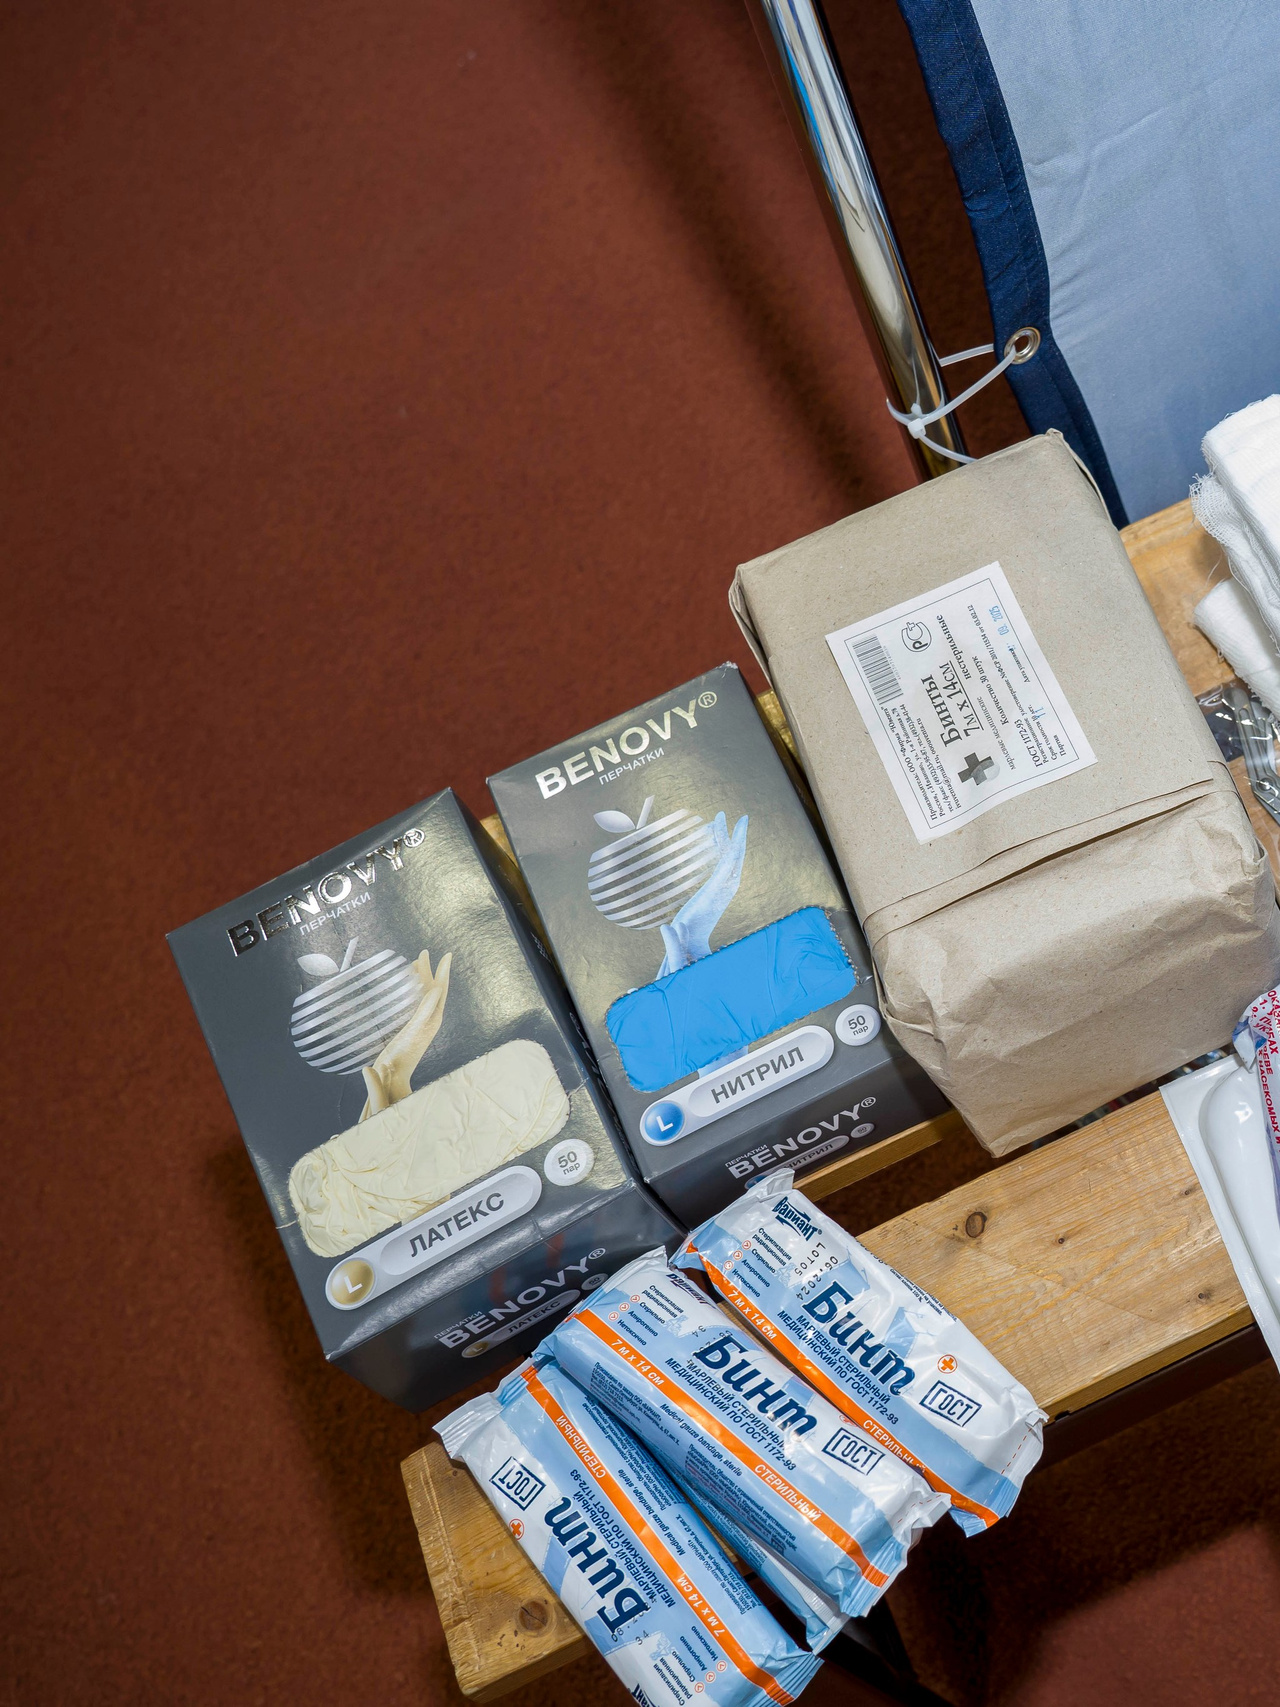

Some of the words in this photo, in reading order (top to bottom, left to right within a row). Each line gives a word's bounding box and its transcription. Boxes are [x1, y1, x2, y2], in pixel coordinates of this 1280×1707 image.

[935, 612, 973, 680] нестерильные
[970, 654, 986, 675] штук
[979, 674, 988, 684] 30
[920, 674, 963, 748] Бинты
[975, 694, 1001, 740] медицинские
[983, 682, 1009, 726] Количество
[1013, 717, 1031, 744] 1172-93
[597, 745, 664, 786] ПЕРЧАТКИ
[903, 755, 916, 773] ООО
[1025, 743, 1042, 767] ГОСТ
[298, 891, 372, 935] ПЕРЧАТКИ
[846, 1013, 867, 1031] 50
[852, 1023, 869, 1037] пар
[654, 1111, 674, 1132] L
[709, 1045, 805, 1105] НИТРИЛ
[558, 1151, 578, 1169] 50
[563, 1162, 581, 1175] пар
[724, 1142, 767, 1168] ПЕРЧАТКИ
[342, 1272, 362, 1293] L
[408, 1191, 508, 1259] ЛАТЕКС
[751, 1233, 787, 1266] радиационная
[756, 1226, 793, 1261] Стерилизация
[739, 1258, 772, 1288] Апирогенно
[749, 1248, 777, 1274] Стерильно
[506, 1299, 562, 1333] ЛАТЕКС
[638, 1300, 665, 1325] Стерильно
[642, 1287, 678, 1320] радиационная
[648, 1283, 684, 1315] Стерилизация
[727, 1289, 738, 1300] 7
[750, 1312, 765, 1326] 14
[760, 1323, 778, 1340] см
[433, 1310, 483, 1339] ПЕРЧАТКИ
[616, 1319, 647, 1347] Нетоксично
[627, 1309, 658, 1338] Апирогенно
[802, 1279, 916, 1398] Бинт
[611, 1337, 622, 1349] 7
[635, 1359, 650, 1373] 14
[647, 1370, 664, 1386] см
[775, 1309, 839, 1368] МЕДИЦИНСКИЙ
[834, 1365, 848, 1379] ПО
[845, 1376, 868, 1398] ГОСТ
[866, 1395, 899, 1425] 1172-93
[794, 1313, 841, 1357] МАРЛЕВЫЙ
[836, 1353, 892, 1404] СТЕРИЛЬНЫЙ
[686, 1359, 734, 1404] МАРЛЕВЫЙ
[693, 1333, 818, 1438] Бинт
[663, 1354, 730, 1415] МЕДИЦИНСКИЙ
[726, 1408, 743, 1425] ПО
[739, 1420, 766, 1445] ГОСТ
[763, 1441, 796, 1472] 1172-93
[927, 1382, 973, 1427] ГОСТ
[554, 1414, 607, 1480] СТЕРИЛЬНЫЙ
[679, 1421, 699, 1439] gauze
[696, 1435, 725, 1462] bandage,
[722, 1457, 743, 1477] sterile
[830, 1429, 877, 1475] ГОСТ
[496, 1461, 540, 1506] ГОСТ
[569, 1468, 597, 1501] 1172-93
[616, 1467, 635, 1488] sterile
[753, 1460, 823, 1523] СТЕРИЛЬНЫЙ
[592, 1499, 614, 1525] ГОСТ
[630, 1484, 656, 1515] bandage,
[571, 1489, 620, 1551] СТЕРИЛЬНЫЙ
[610, 1522, 625, 1539] ПО
[651, 1511, 669, 1532] gauze
[664, 1530, 685, 1556] Medical
[543, 1496, 652, 1635] Бинт
[613, 1547, 657, 1601] МАРЛЕВЫЙ
[618, 1536, 677, 1609] МЕДИЦИНСКИЙ
[676, 1575, 693, 1593] см
[688, 1592, 703, 1608] 14
[689, 1624, 718, 1661] Нетоксично
[713, 1625, 725, 1637] 7
[670, 1649, 696, 1682] Стерильно
[678, 1634, 708, 1671] Апирогенно
[652, 1662, 686, 1706] Стерилизация
[658, 1656, 692, 1699] радиационная
